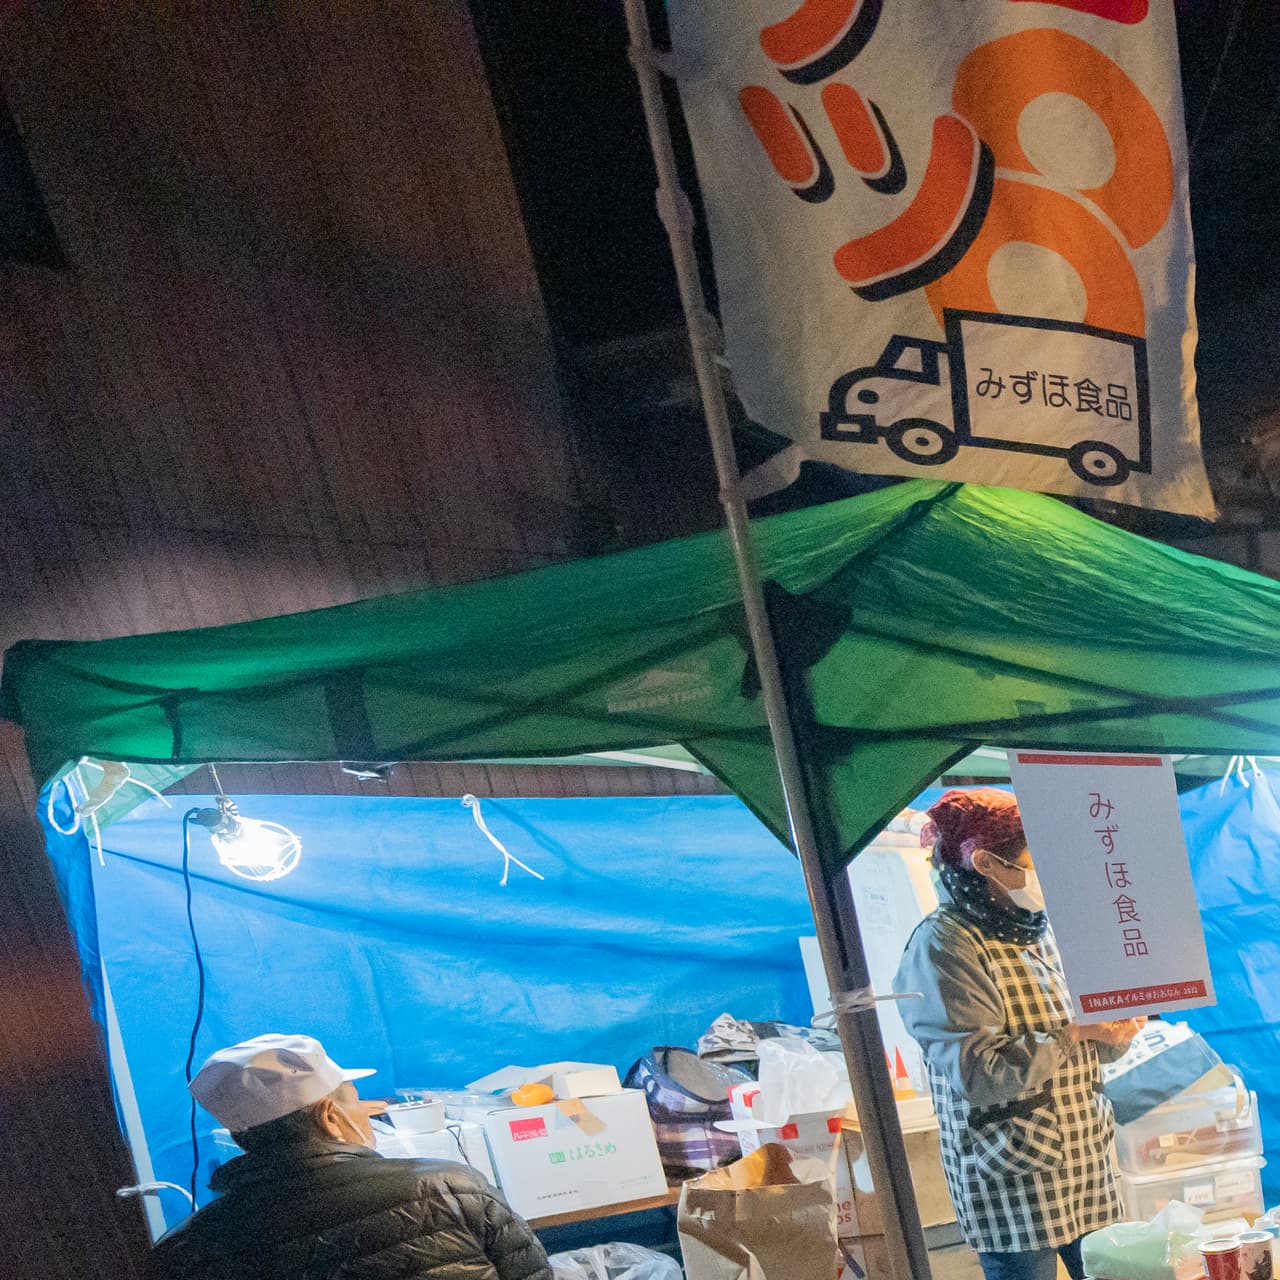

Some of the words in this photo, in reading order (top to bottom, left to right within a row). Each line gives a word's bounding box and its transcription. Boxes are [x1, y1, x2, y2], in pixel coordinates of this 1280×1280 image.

[975, 366, 1133, 422] みずほ食品
[1087, 792, 1148, 958] みずほ食品
